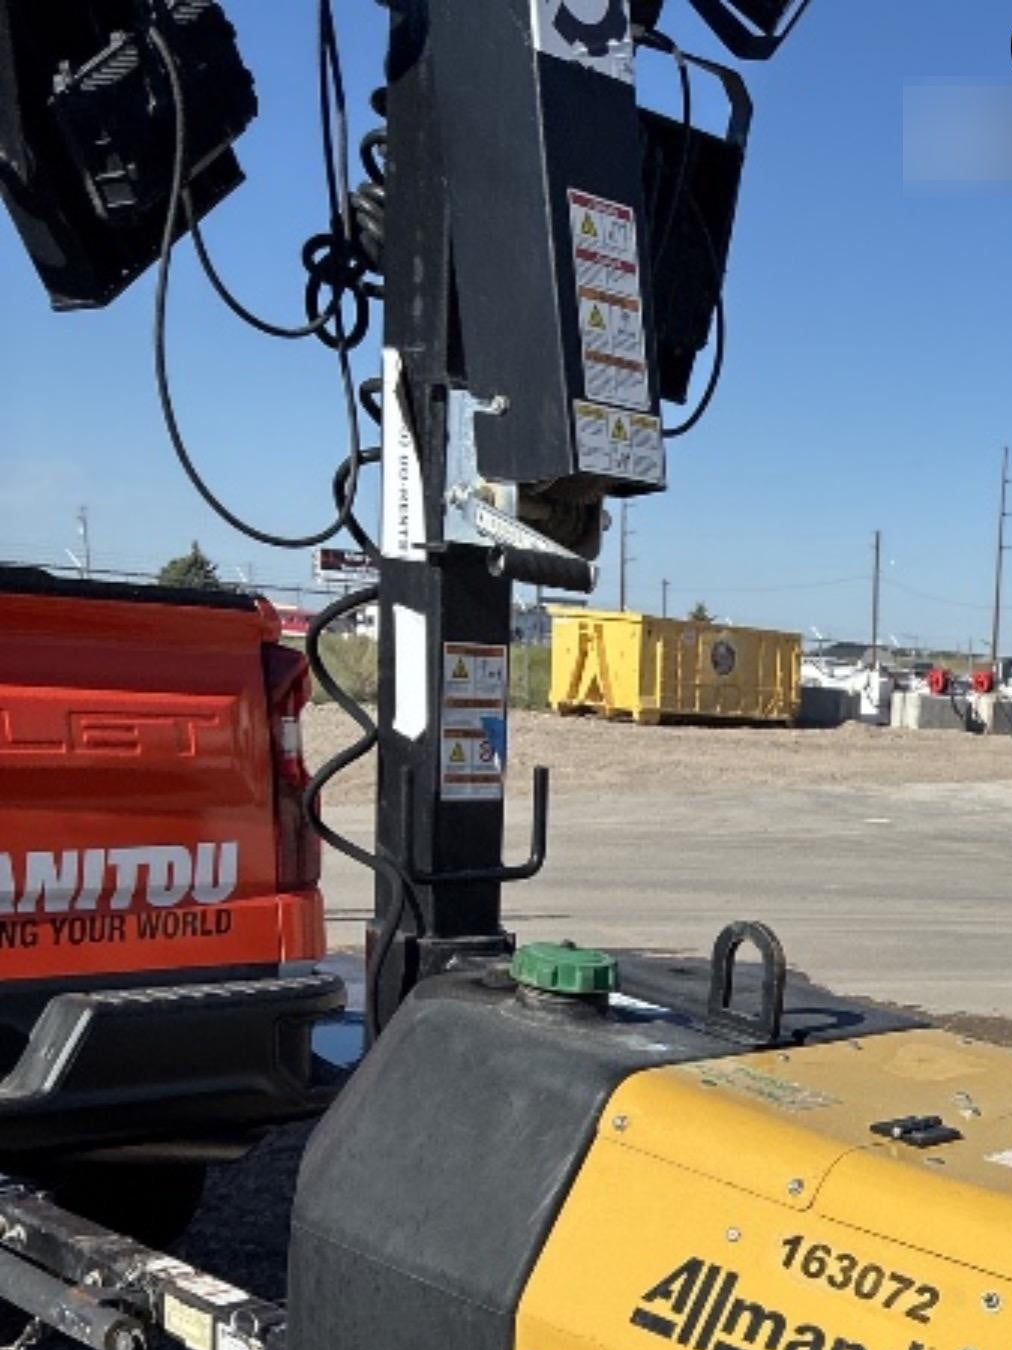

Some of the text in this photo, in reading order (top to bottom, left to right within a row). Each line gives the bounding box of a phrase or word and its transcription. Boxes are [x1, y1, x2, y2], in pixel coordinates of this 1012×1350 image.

[50, 914, 126, 945] YOUR
[136, 908, 233, 940] WORLD
[781, 1235, 940, 1324] 163072
